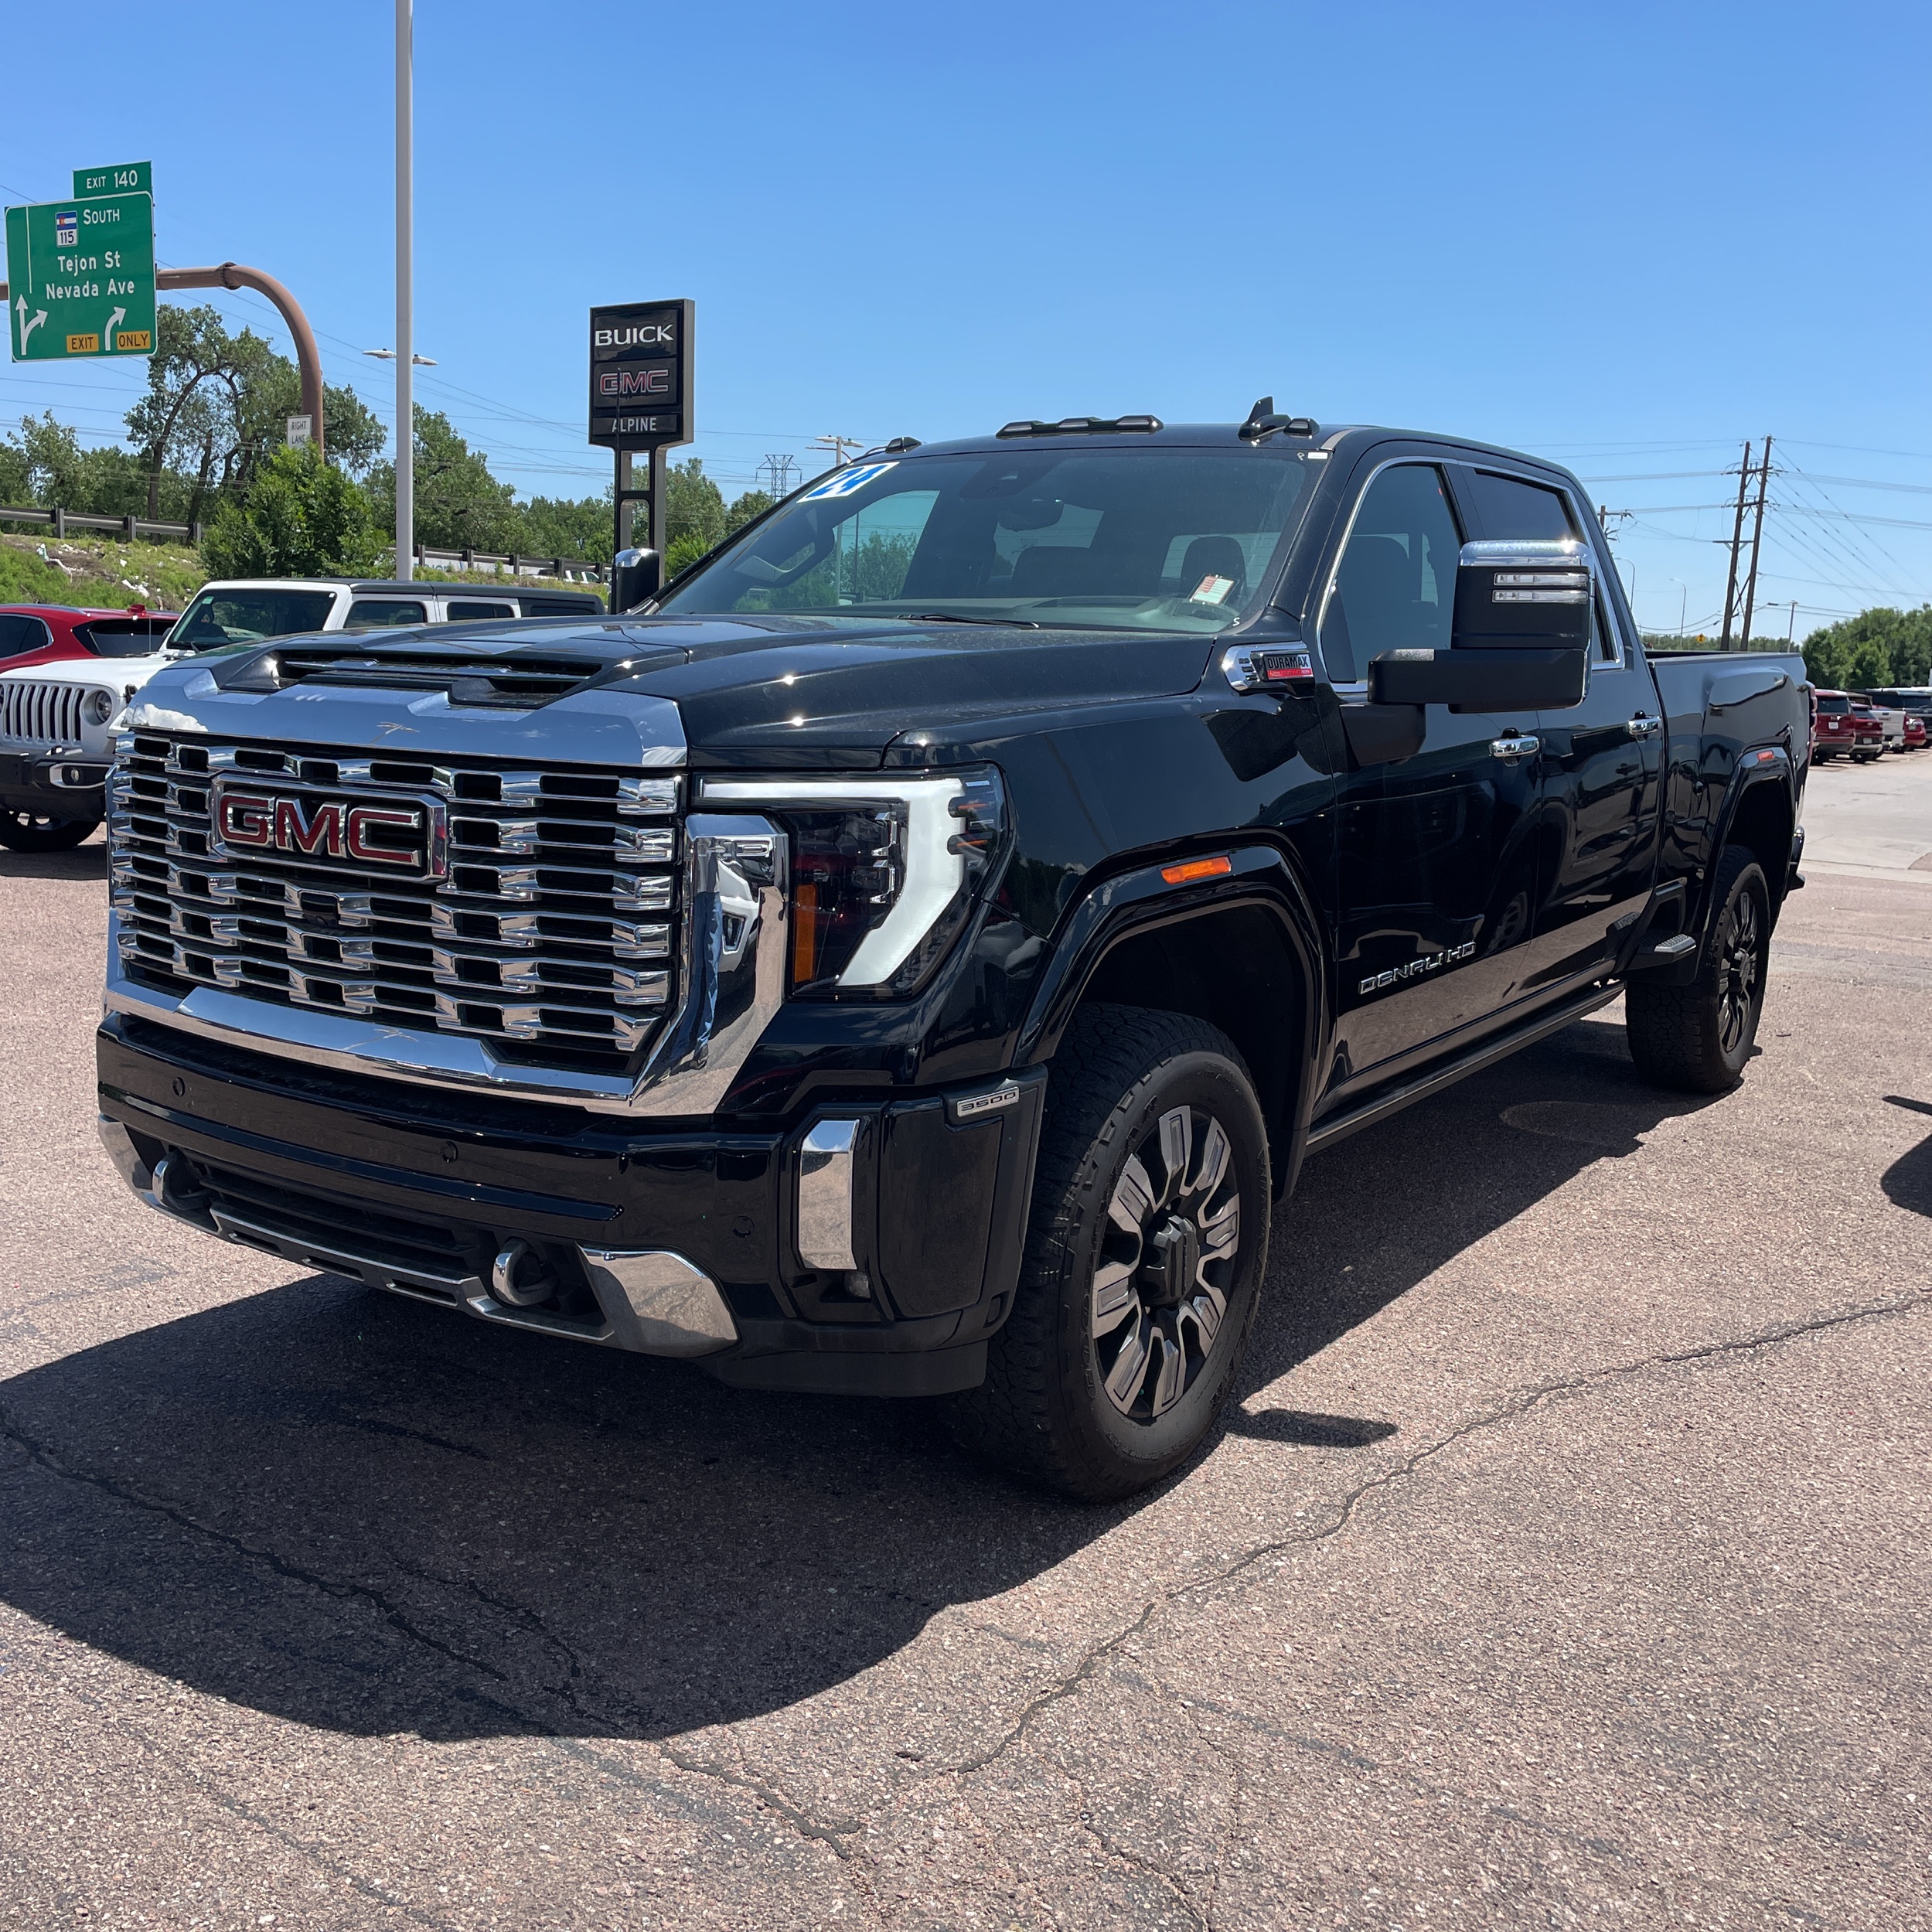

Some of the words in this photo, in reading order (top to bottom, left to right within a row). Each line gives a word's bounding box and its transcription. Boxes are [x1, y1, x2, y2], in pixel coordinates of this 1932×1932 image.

[87, 176, 106, 189] EXIT
[114, 169, 138, 188] 140
[83, 208, 120, 225] SOUTH
[60, 230, 74, 244] 115
[57, 254, 97, 277] Tejon
[104, 250, 121, 268] St
[46, 281, 99, 300] Nevada
[107, 278, 135, 295] Ave
[71, 337, 94, 350] EXIT
[118, 333, 148, 347] ONLY
[595, 324, 674, 346] BUICK
[599, 369, 669, 395] GMC
[291, 421, 307, 431] RIGHT
[612, 417, 657, 433] ALPINE
[1268, 656, 1309, 669] DURAMAX
[219, 790, 422, 867] GMC
[1358, 952, 1443, 995] DENALI
[1446, 941, 1476, 963] HD
[961, 1092, 1016, 1112] 3500
